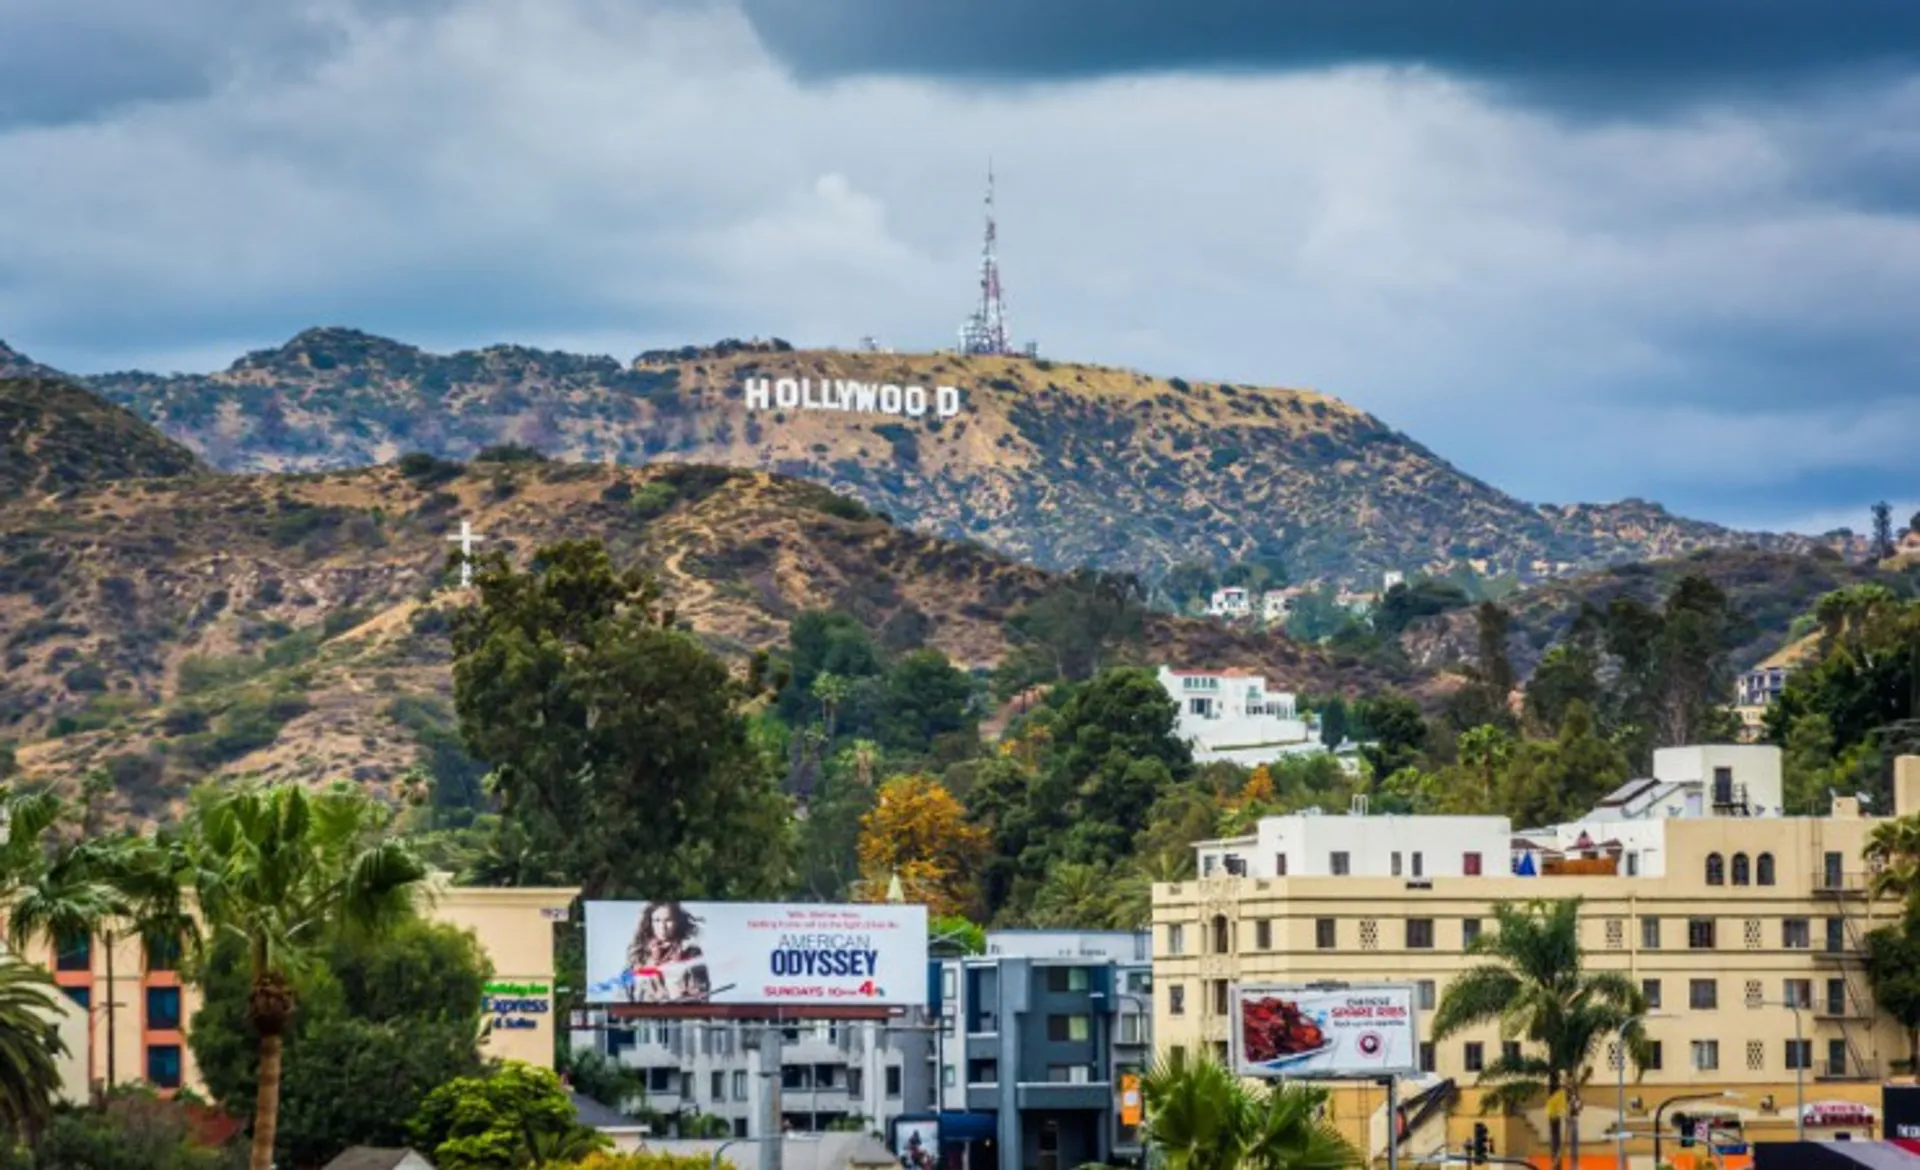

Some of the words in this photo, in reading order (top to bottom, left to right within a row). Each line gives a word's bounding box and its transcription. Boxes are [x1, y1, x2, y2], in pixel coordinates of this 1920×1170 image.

[745, 378, 960, 416] HOLLYWOOD
[779, 934, 871, 949] AMERICAN
[770, 949, 878, 977] ODYSSEY
[763, 986, 824, 997] SUNDAYS
[481, 996, 549, 1015] Express
